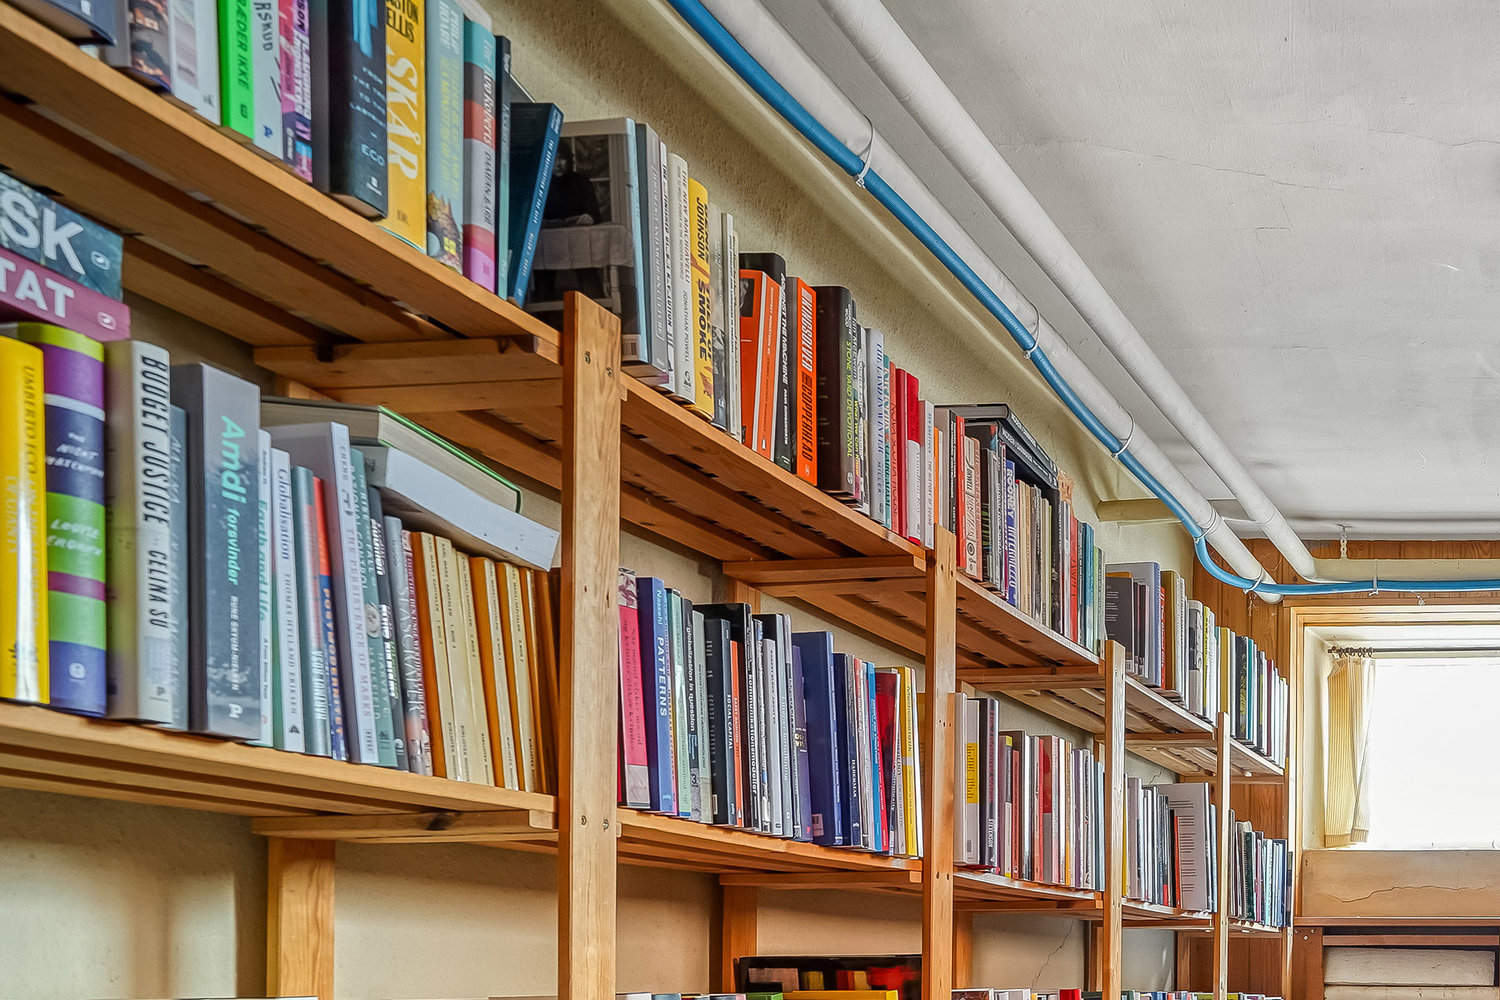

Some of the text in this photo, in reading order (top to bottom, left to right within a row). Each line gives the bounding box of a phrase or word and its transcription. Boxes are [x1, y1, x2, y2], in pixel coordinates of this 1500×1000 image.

[387, 46, 422, 180] SKÅR
[484, 91, 494, 146] Roberts
[361, 144, 386, 167] ECO
[683, 218, 691, 285] MACHIAVELLI
[696, 197, 706, 261] JOHNSON
[682, 291, 690, 330] JONATHAN
[698, 279, 707, 361] SMOKE
[801, 300, 813, 373] KINGSOLVER
[22, 366, 36, 475] UMBERTO ECO
[142, 356, 170, 525] BUDGET JUSTICE
[802, 384, 813, 462] COPPERHEAD
[220, 416, 247, 586] Amdi forsvinder
[277, 468, 291, 561] Globalisation
[1007, 468, 1017, 587] ROONEY INTERMEZZO
[348, 529, 358, 556] THE
[148, 550, 169, 628] CELINA SU
[349, 561, 365, 650] PERSISTENCE
[322, 589, 344, 737] POSTMODERNITET
[399, 586, 422, 713] SEASCRAPER
[657, 636, 668, 717] PATTERNS
[686, 627, 694, 681] globalization
[361, 676, 372, 719] MASKS
[688, 693, 696, 731] question
[748, 674, 758, 794] kommunikationsmodeller
